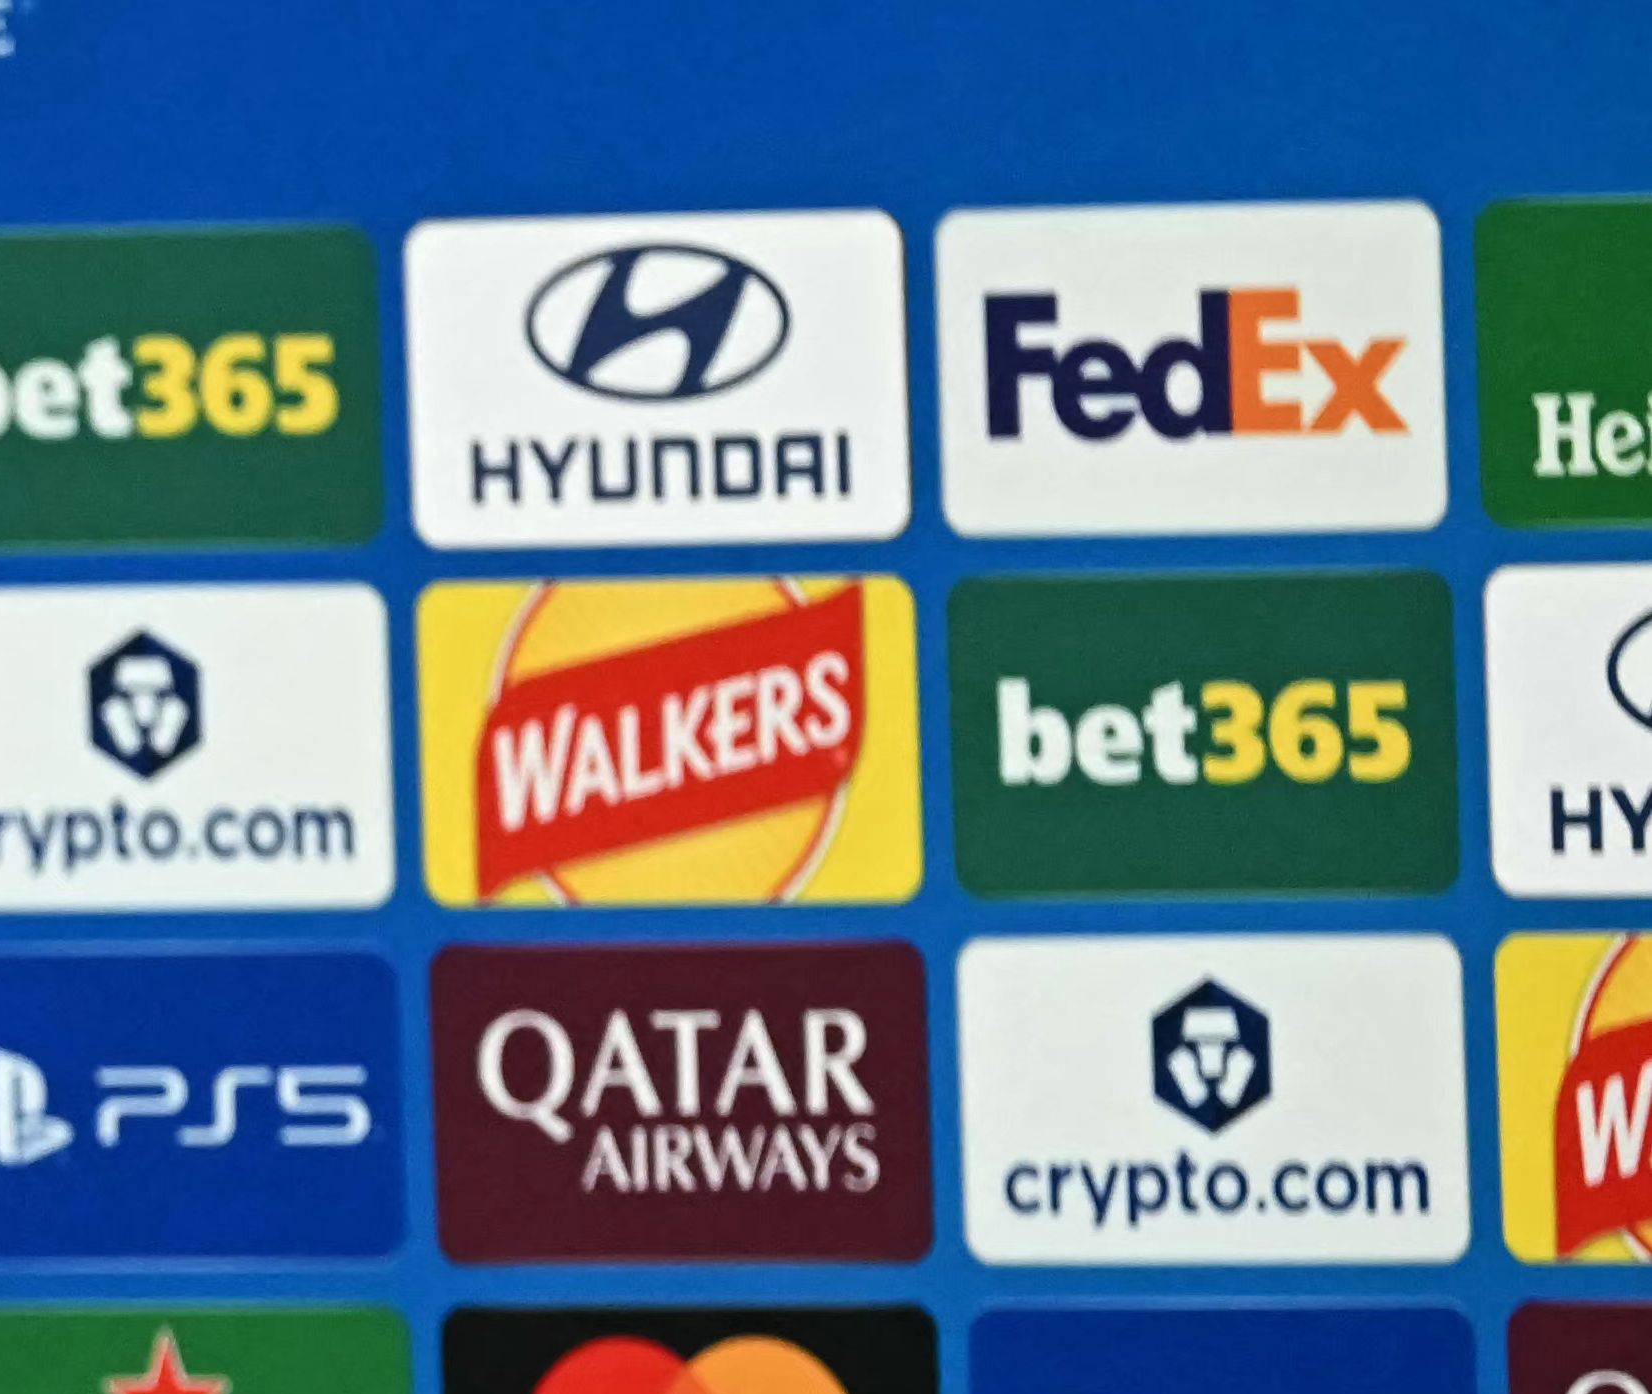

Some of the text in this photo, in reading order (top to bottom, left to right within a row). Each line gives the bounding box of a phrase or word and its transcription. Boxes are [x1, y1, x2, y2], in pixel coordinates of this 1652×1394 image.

[983, 287, 1412, 443] FedEx
[470, 430, 850, 506] HYUNDAI
[494, 650, 851, 832] WALKERS
[997, 677, 1412, 786] bet365
[95, 1065, 372, 1147] PS5
[477, 1008, 875, 1145] QATAR
[581, 1121, 881, 1194] AIRWAYS
[1004, 1148, 1430, 1230] crypto.com
